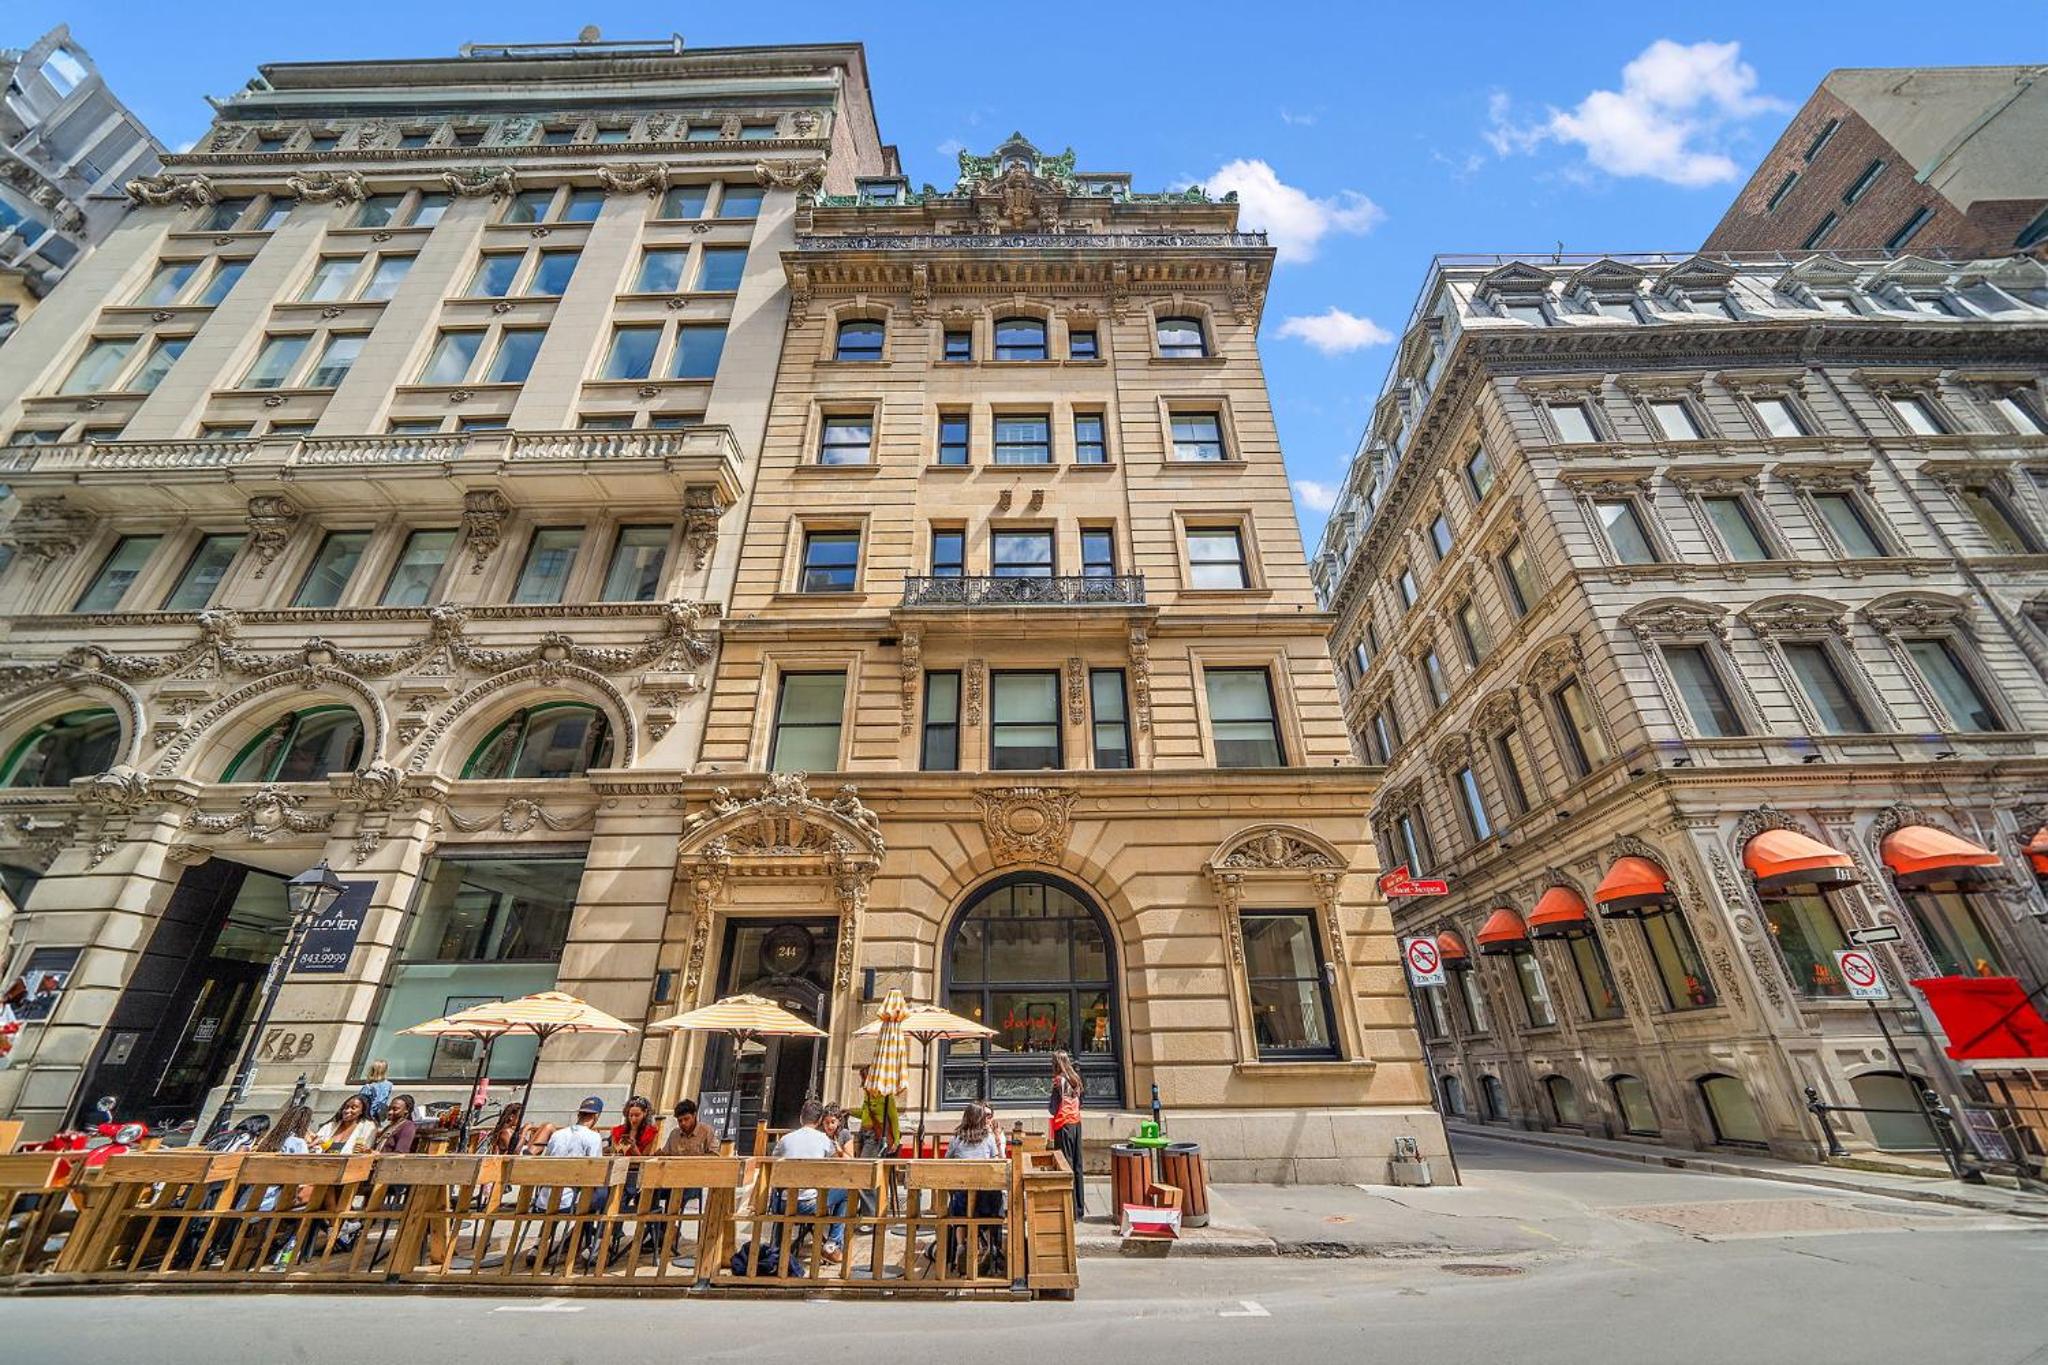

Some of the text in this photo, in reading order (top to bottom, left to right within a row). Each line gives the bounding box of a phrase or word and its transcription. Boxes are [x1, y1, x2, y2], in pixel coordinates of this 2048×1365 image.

[312, 919, 358, 930] LOUER
[778, 946, 797, 957] 244
[299, 953, 347, 964] 843.9999
[257, 1028, 315, 1059] KRB
